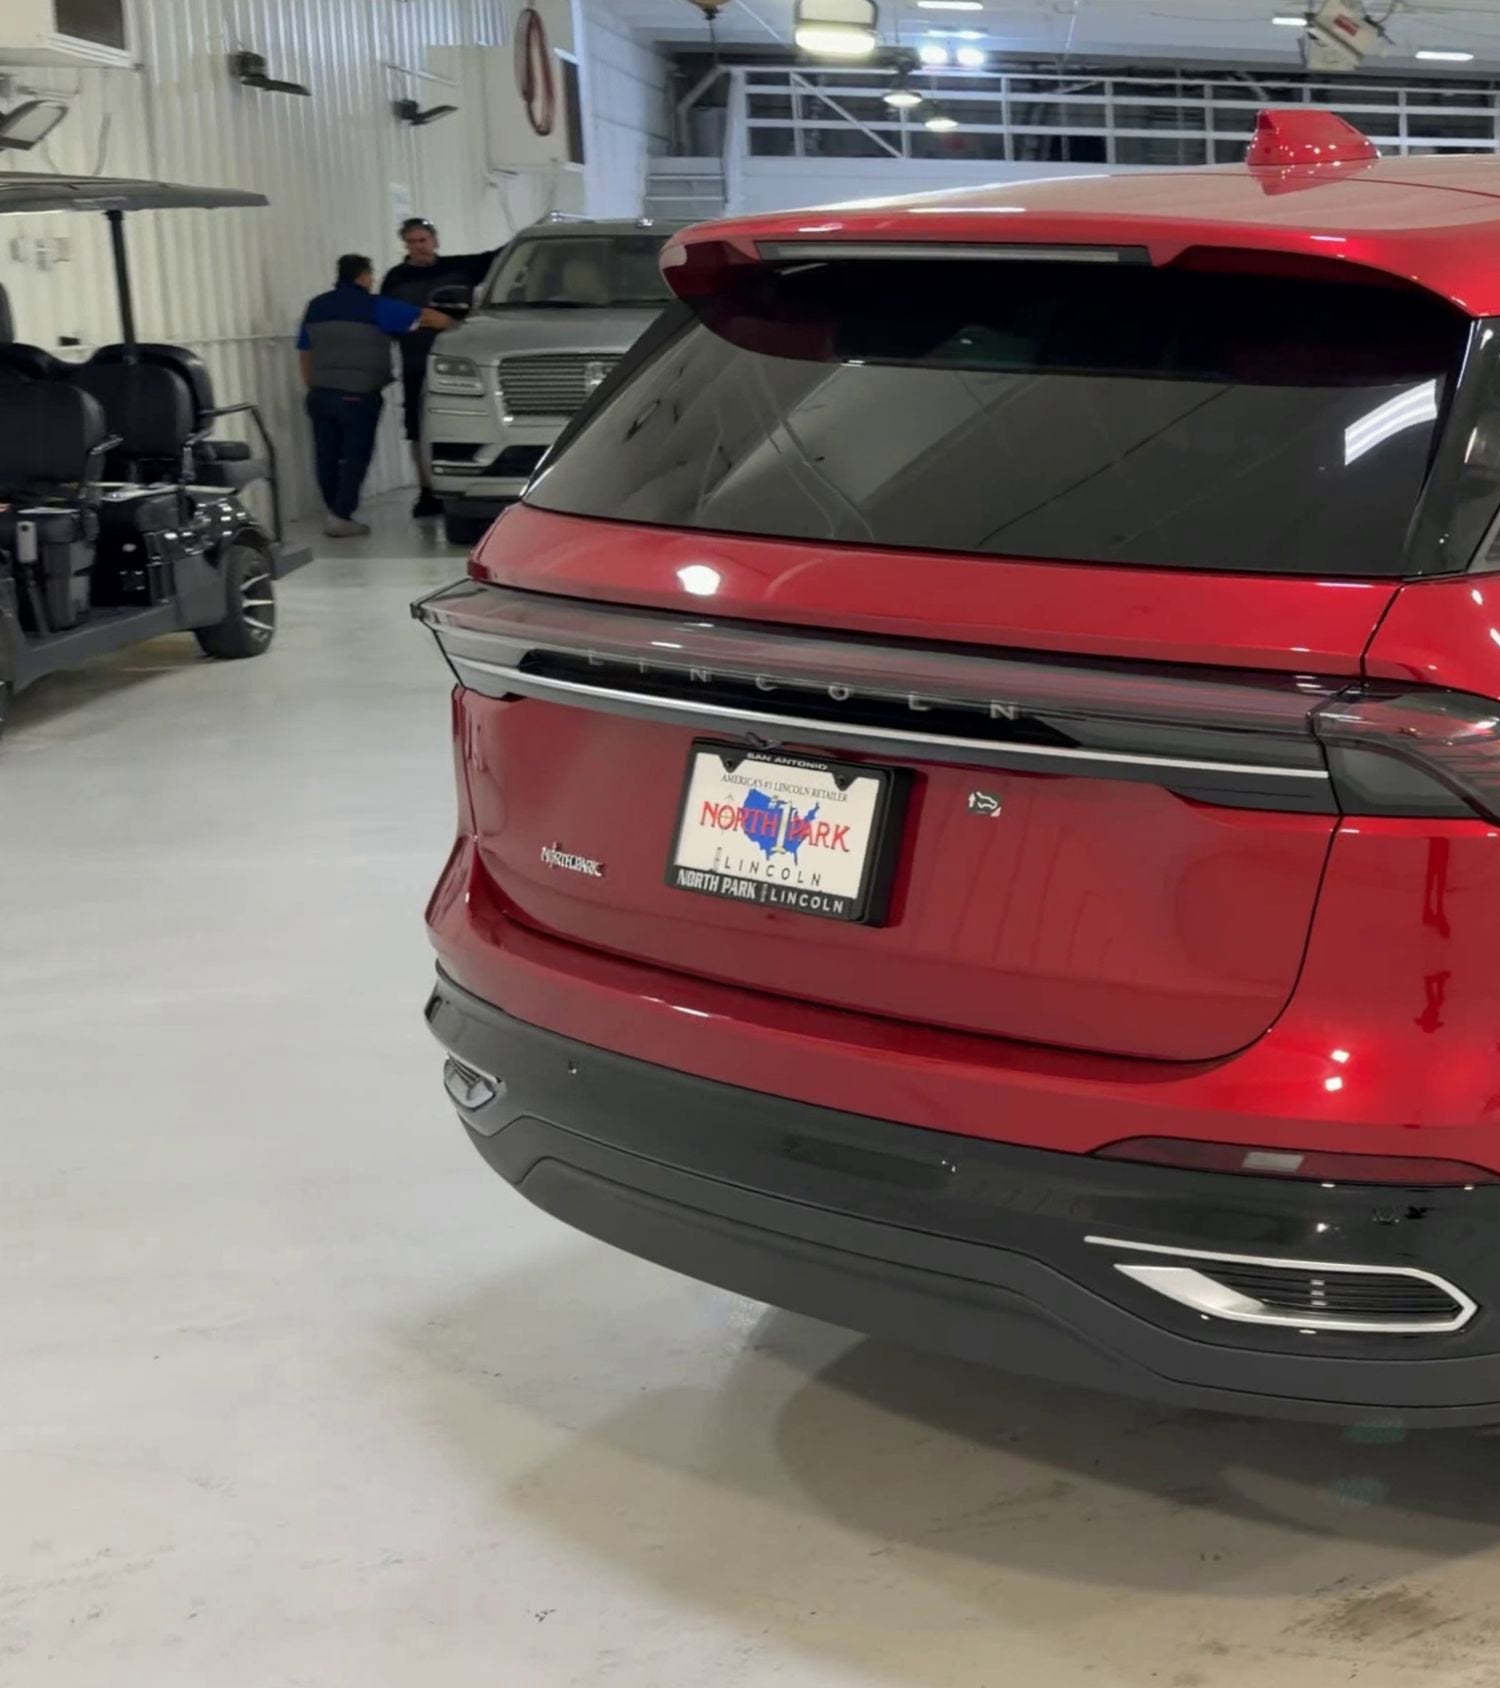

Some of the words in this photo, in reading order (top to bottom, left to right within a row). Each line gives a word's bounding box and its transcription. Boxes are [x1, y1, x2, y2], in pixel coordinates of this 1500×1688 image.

[587, 646, 1021, 720] LINCOLN
[746, 752, 772, 762] SAN
[774, 757, 828, 770] ANTONIO
[721, 774, 763, 789] AMERICA'S
[774, 781, 811, 797] LINCOLN
[811, 788, 848, 803] RETAILER
[700, 800, 779, 838] NORTH
[788, 811, 851, 853] PARK
[724, 856, 821, 886] LINCOLN
[677, 868, 720, 892] NORTH
[721, 876, 757, 900] PARK
[770, 887, 844, 914] LINCOLN
